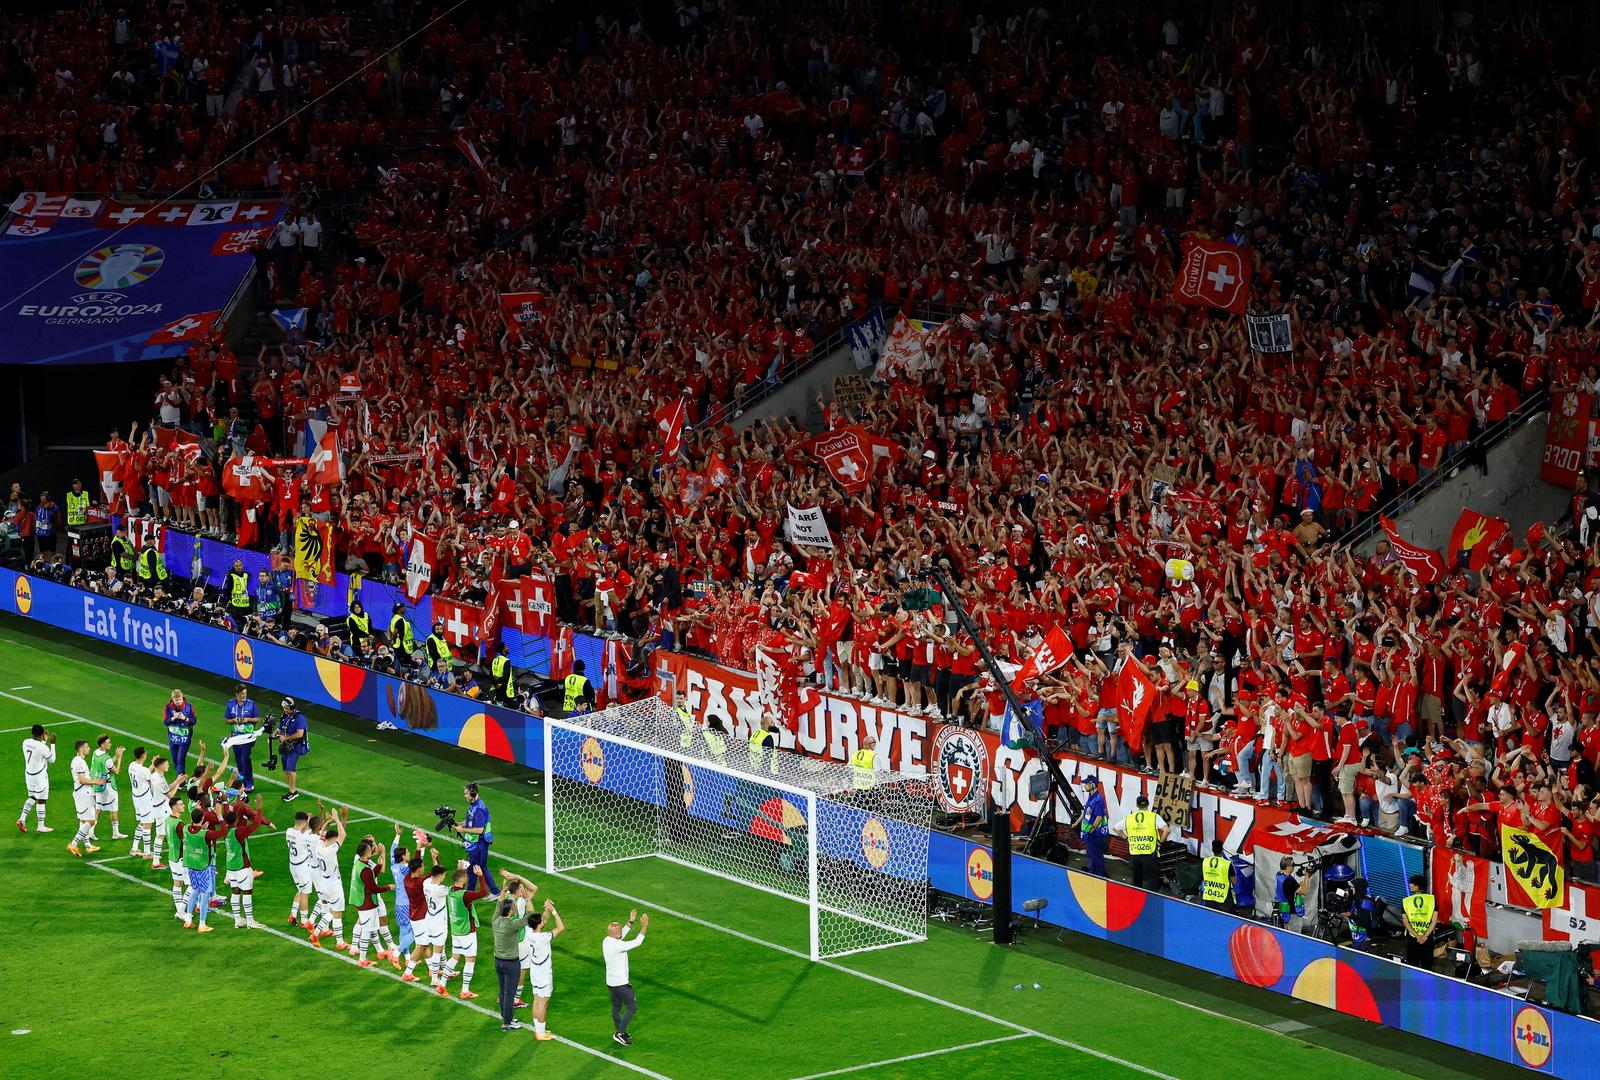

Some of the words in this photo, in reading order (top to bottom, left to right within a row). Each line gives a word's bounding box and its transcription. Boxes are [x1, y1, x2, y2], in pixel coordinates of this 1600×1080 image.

[1187, 252, 1201, 293] SCHWEIZ
[73, 293, 122, 303] UEFA
[45, 317, 124, 325] GERMANY
[1253, 315, 1283, 324] GRANIT
[835, 376, 861, 387] ALPS
[820, 436, 855, 454] SCHWEIZ
[1544, 444, 1580, 471] 8730
[798, 512, 818, 521] ARE
[795, 523, 812, 532] NOT
[793, 531, 829, 543] SWEDEN
[84, 596, 118, 640] Eat
[122, 606, 178, 657] fresh
[27, 749, 33, 765] 7
[1129, 835, 1154, 843] STEWARD
[287, 839, 298, 857] 25
[1204, 880, 1226, 890] EWARD
[1569, 917, 1587, 931] 52
